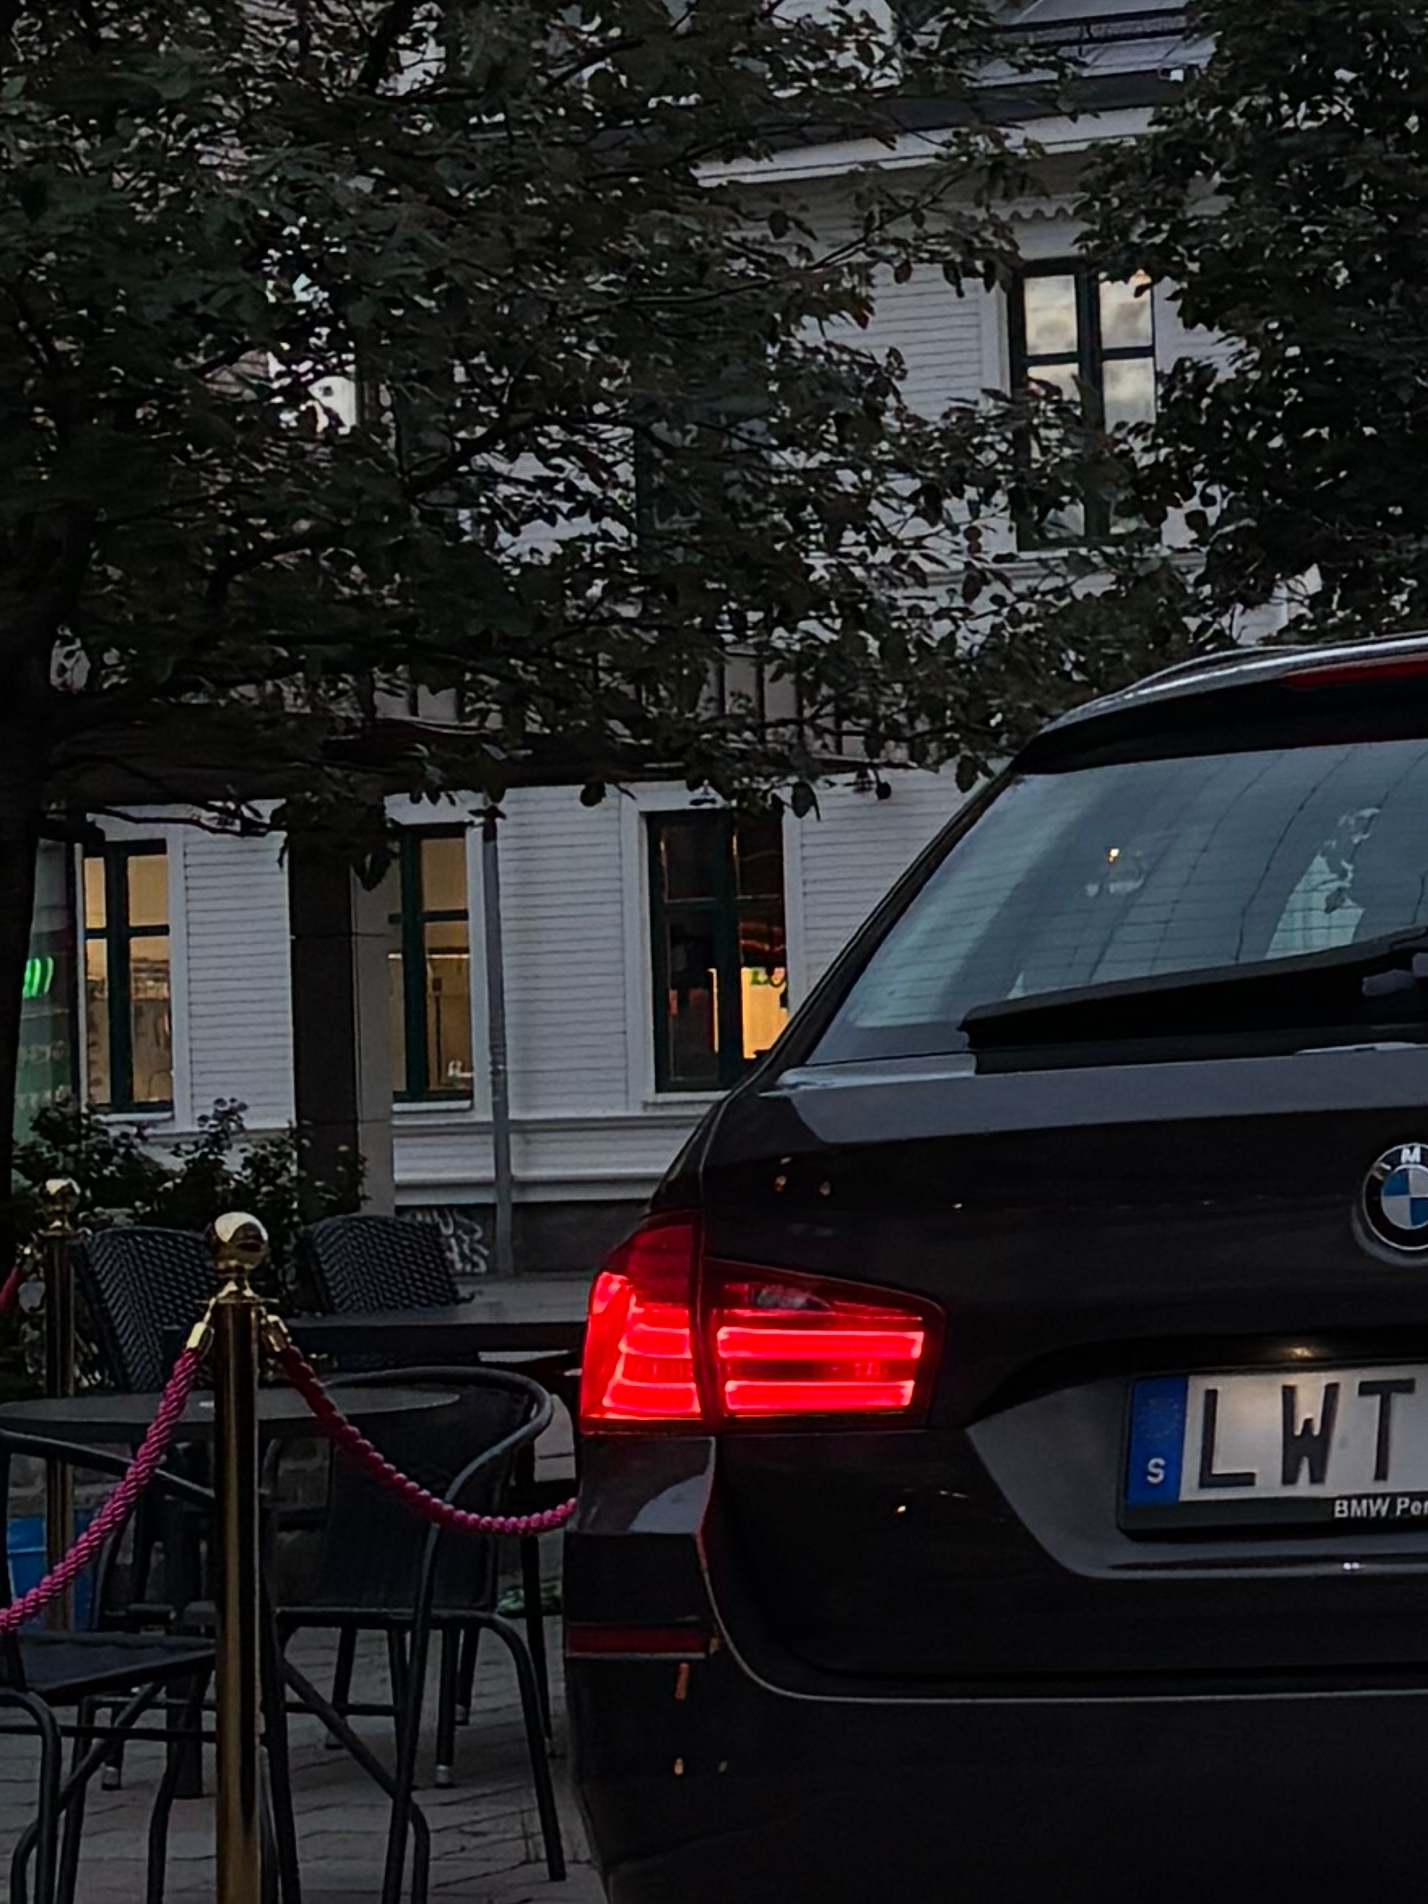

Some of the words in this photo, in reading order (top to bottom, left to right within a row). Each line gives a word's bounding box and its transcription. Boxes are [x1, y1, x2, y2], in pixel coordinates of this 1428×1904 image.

[1199, 1378, 1416, 1489] LWT
[1147, 1458, 1166, 1484] S
[1333, 1498, 1390, 1519] BMW
